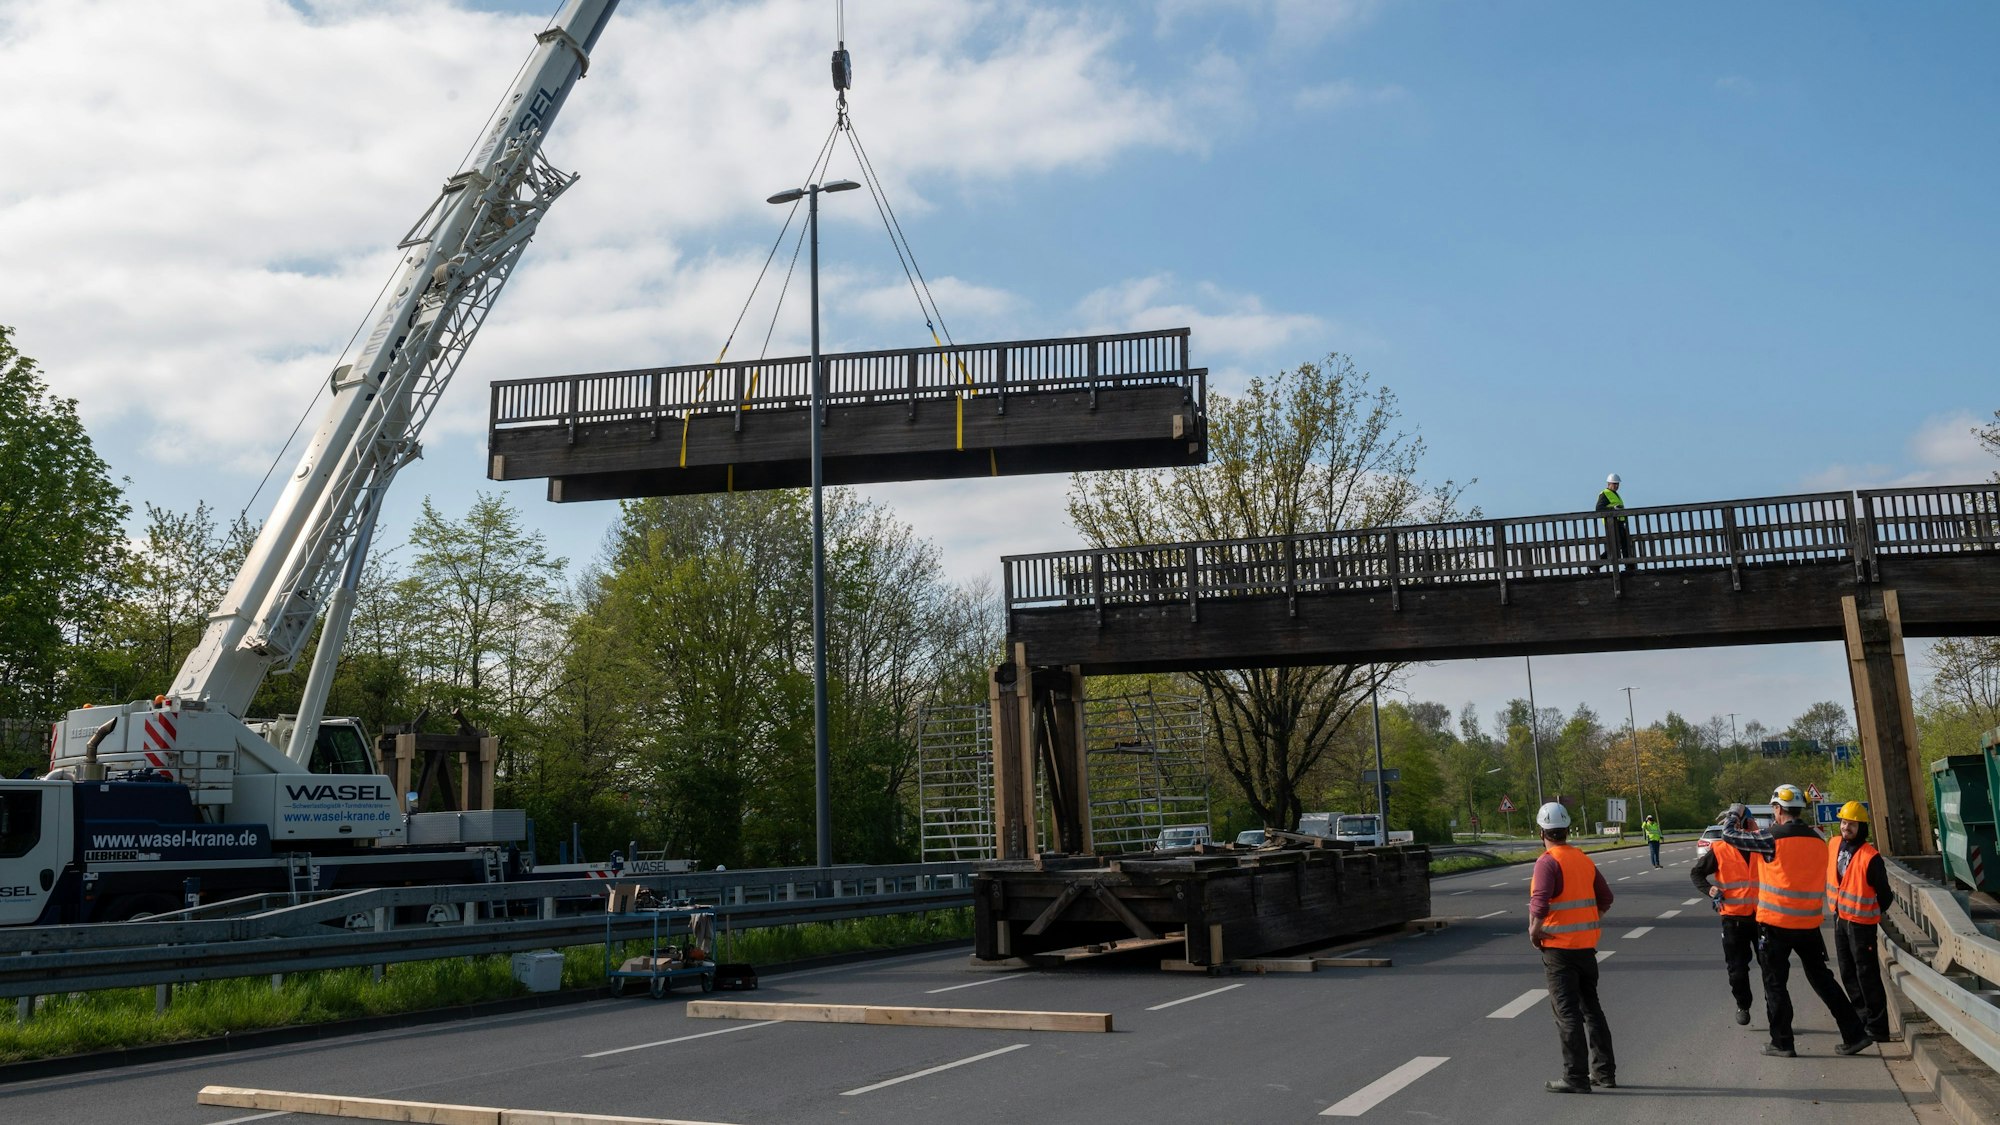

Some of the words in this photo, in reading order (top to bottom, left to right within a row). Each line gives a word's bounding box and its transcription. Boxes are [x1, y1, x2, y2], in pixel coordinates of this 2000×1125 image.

[518, 86, 560, 134] SEL
[285, 784, 391, 801] WASEL
[284, 811, 391, 822] www.wasel-krane.de
[92, 830, 258, 848] www.wasel-krane.de
[85, 850, 138, 861] LIEBHERR
[631, 861, 669, 872] WASEL
